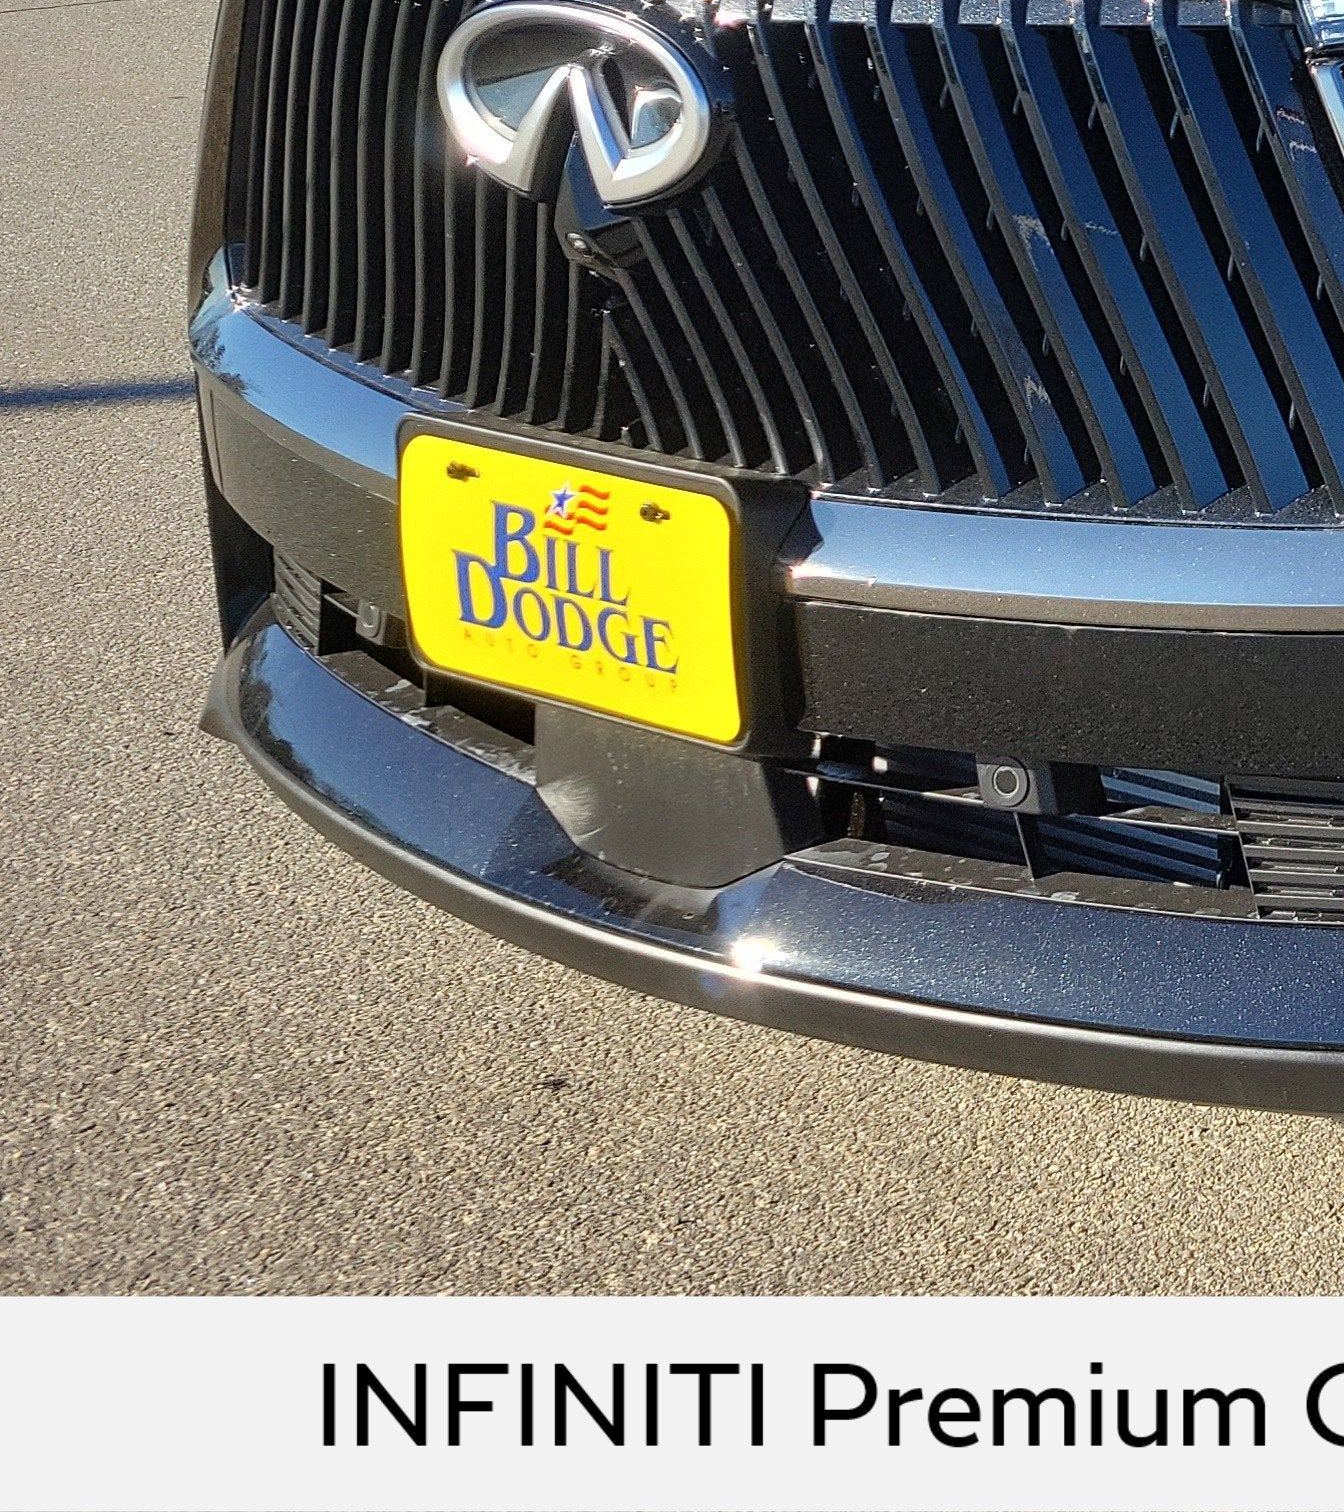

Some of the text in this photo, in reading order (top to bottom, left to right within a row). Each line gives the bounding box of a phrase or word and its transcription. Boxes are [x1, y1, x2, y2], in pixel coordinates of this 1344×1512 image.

[490, 499, 632, 607] BILL
[450, 548, 681, 675] DODGE
[463, 628, 678, 693] AUTO GROUP
